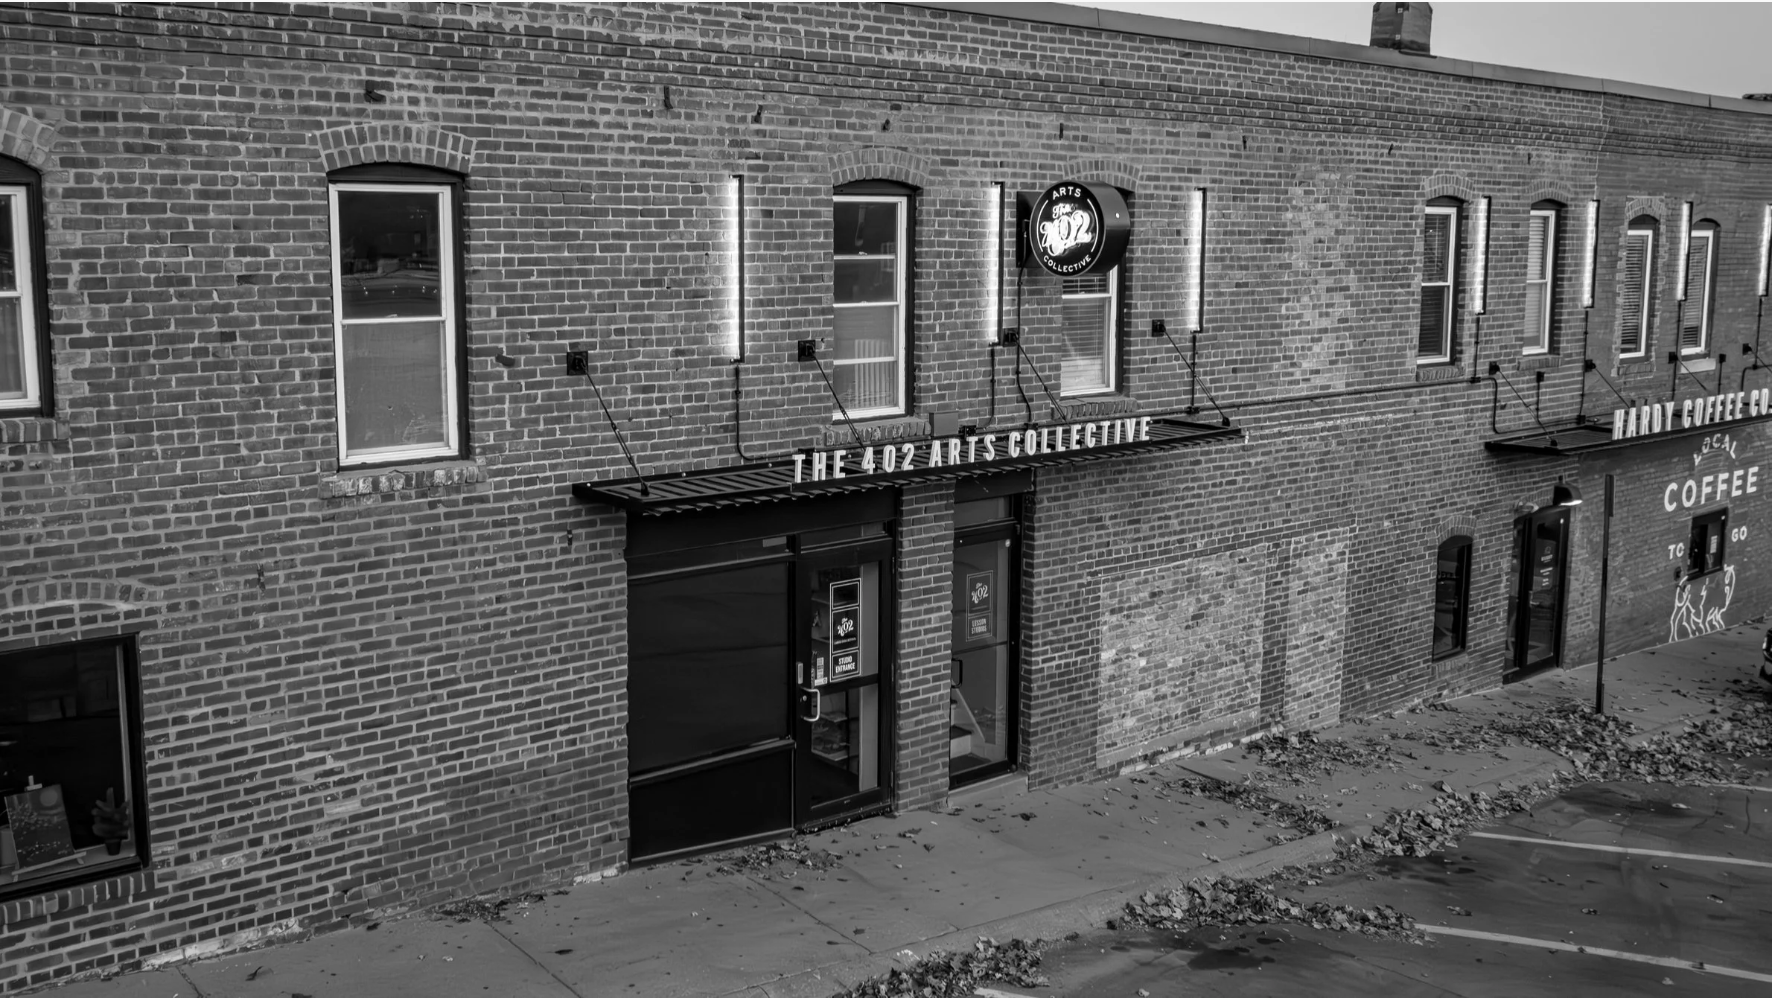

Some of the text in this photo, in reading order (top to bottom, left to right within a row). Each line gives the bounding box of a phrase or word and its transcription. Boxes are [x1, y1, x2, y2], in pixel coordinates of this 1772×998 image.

[1052, 186, 1081, 200] ARTS
[1043, 254, 1092, 273] COLLECTIVE
[1612, 401, 1675, 440] HARDY
[1682, 391, 1745, 429] COFFEE
[792, 416, 1151, 483] THE 402 ARTS COLLECTIVE
[1664, 466, 1760, 512] COFFEE
[1668, 526, 1748, 560] TO GO
[835, 662, 856, 674] ENTRANCE
[838, 655, 853, 665] STUDIO
